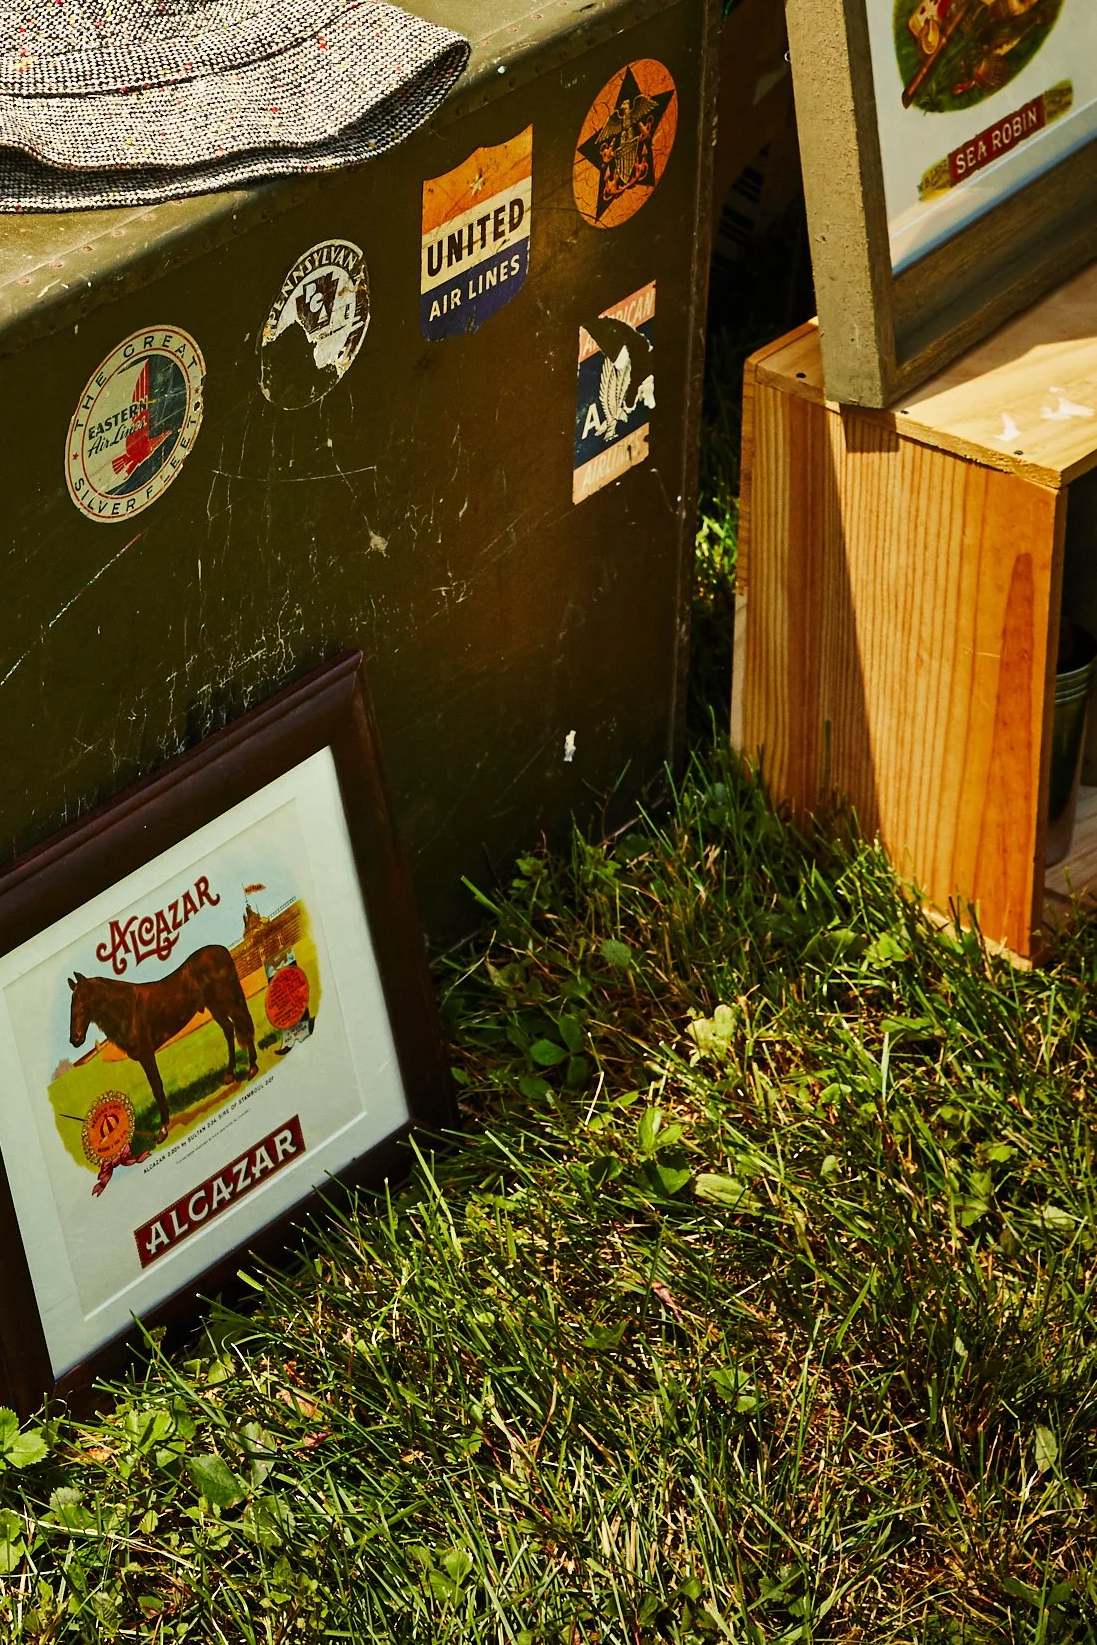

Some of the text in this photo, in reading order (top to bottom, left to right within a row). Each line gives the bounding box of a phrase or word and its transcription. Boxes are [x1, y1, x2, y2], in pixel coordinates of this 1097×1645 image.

[955, 106, 1038, 175] SEA ROBIN
[427, 197, 525, 277] UNITED
[429, 254, 520, 322] AIR LINES
[73, 334, 198, 432] THE GREAT
[88, 397, 149, 441] EASTERN
[74, 415, 197, 516] SILVER FLEET
[88, 435, 110, 458] Air
[96, 876, 221, 975] ALCAZAR
[145, 1129, 298, 1254] ALCAZAR
